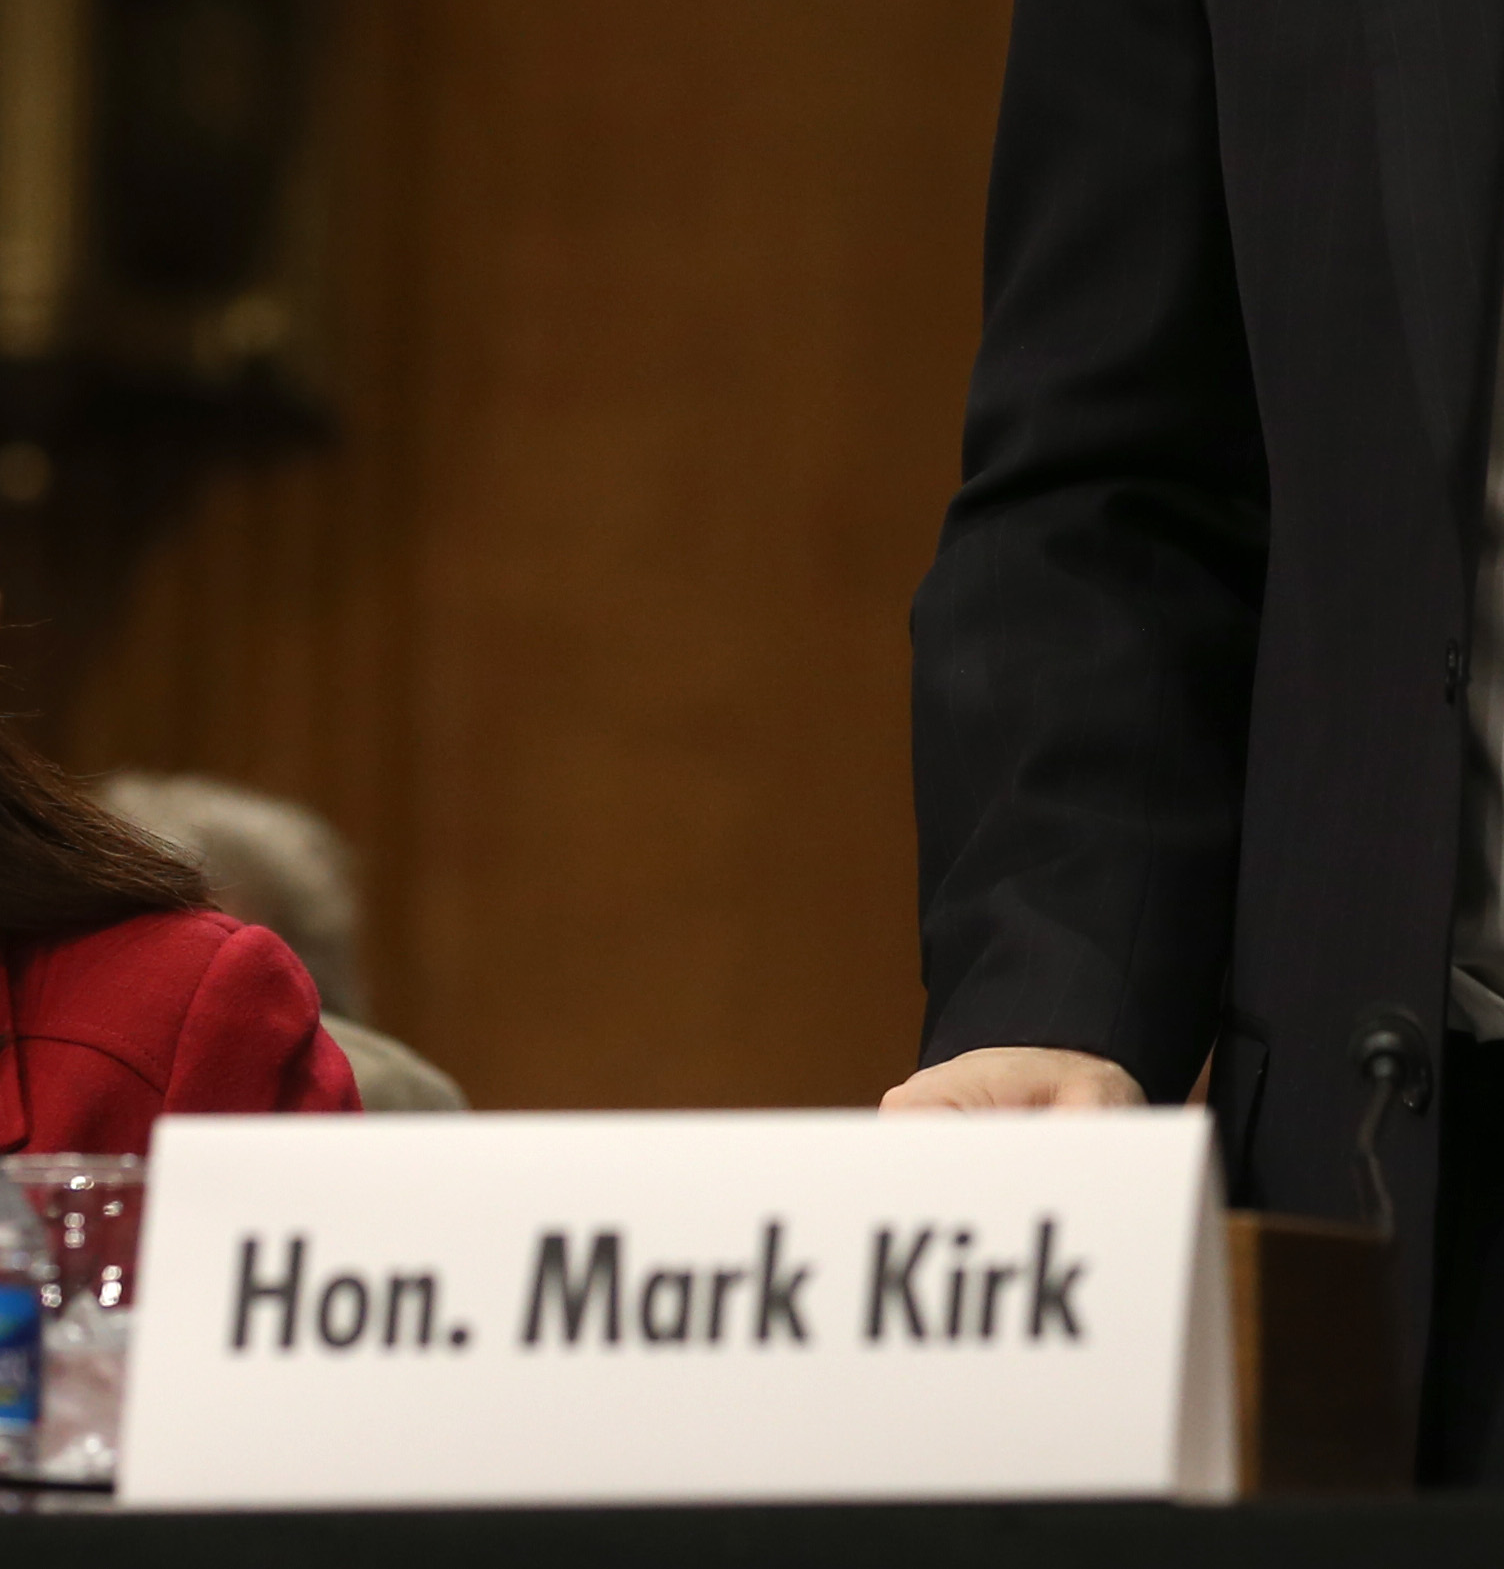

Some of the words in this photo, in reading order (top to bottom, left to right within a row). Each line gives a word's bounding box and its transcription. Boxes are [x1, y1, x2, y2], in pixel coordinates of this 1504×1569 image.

[230, 1235, 470, 1353] Hon.
[520, 1219, 810, 1348] Mark
[863, 1217, 1083, 1343] Kirk
